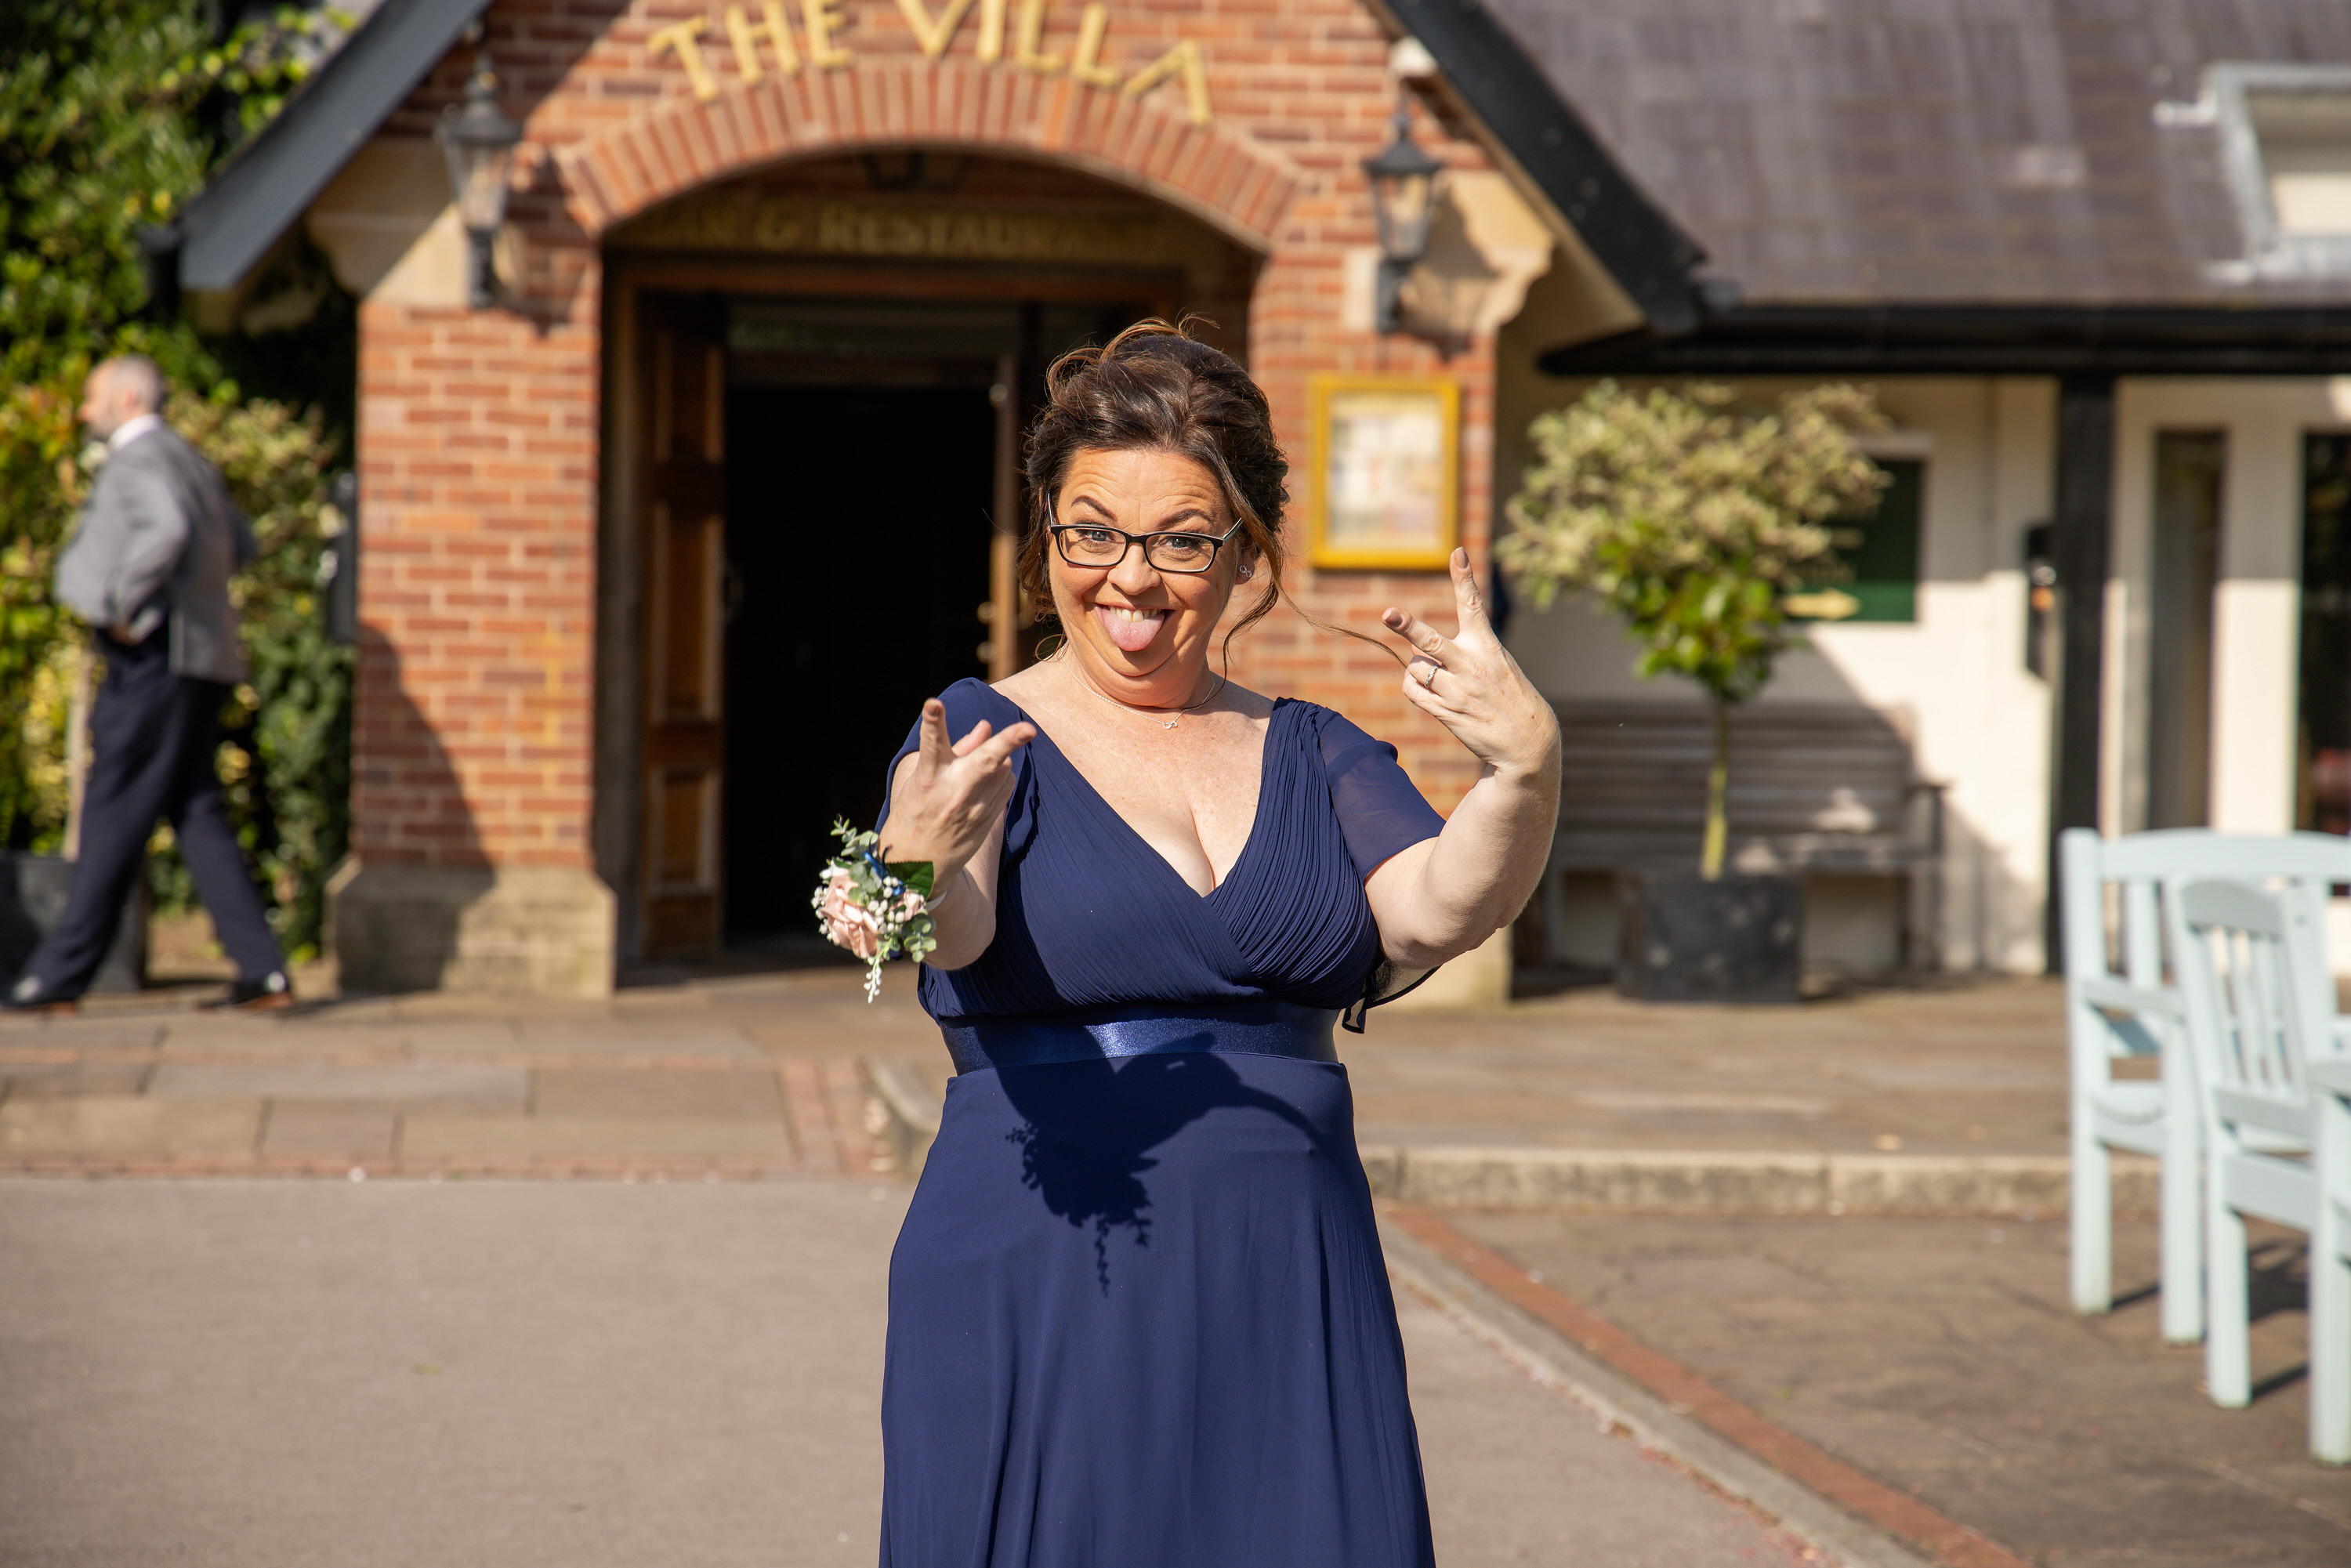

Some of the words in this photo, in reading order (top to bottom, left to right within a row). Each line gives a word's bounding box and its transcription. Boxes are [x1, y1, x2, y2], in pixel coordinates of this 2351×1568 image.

[647, 0, 853, 100] THE
[894, 0, 1213, 124] VILLA
[752, 200, 800, 249] &
